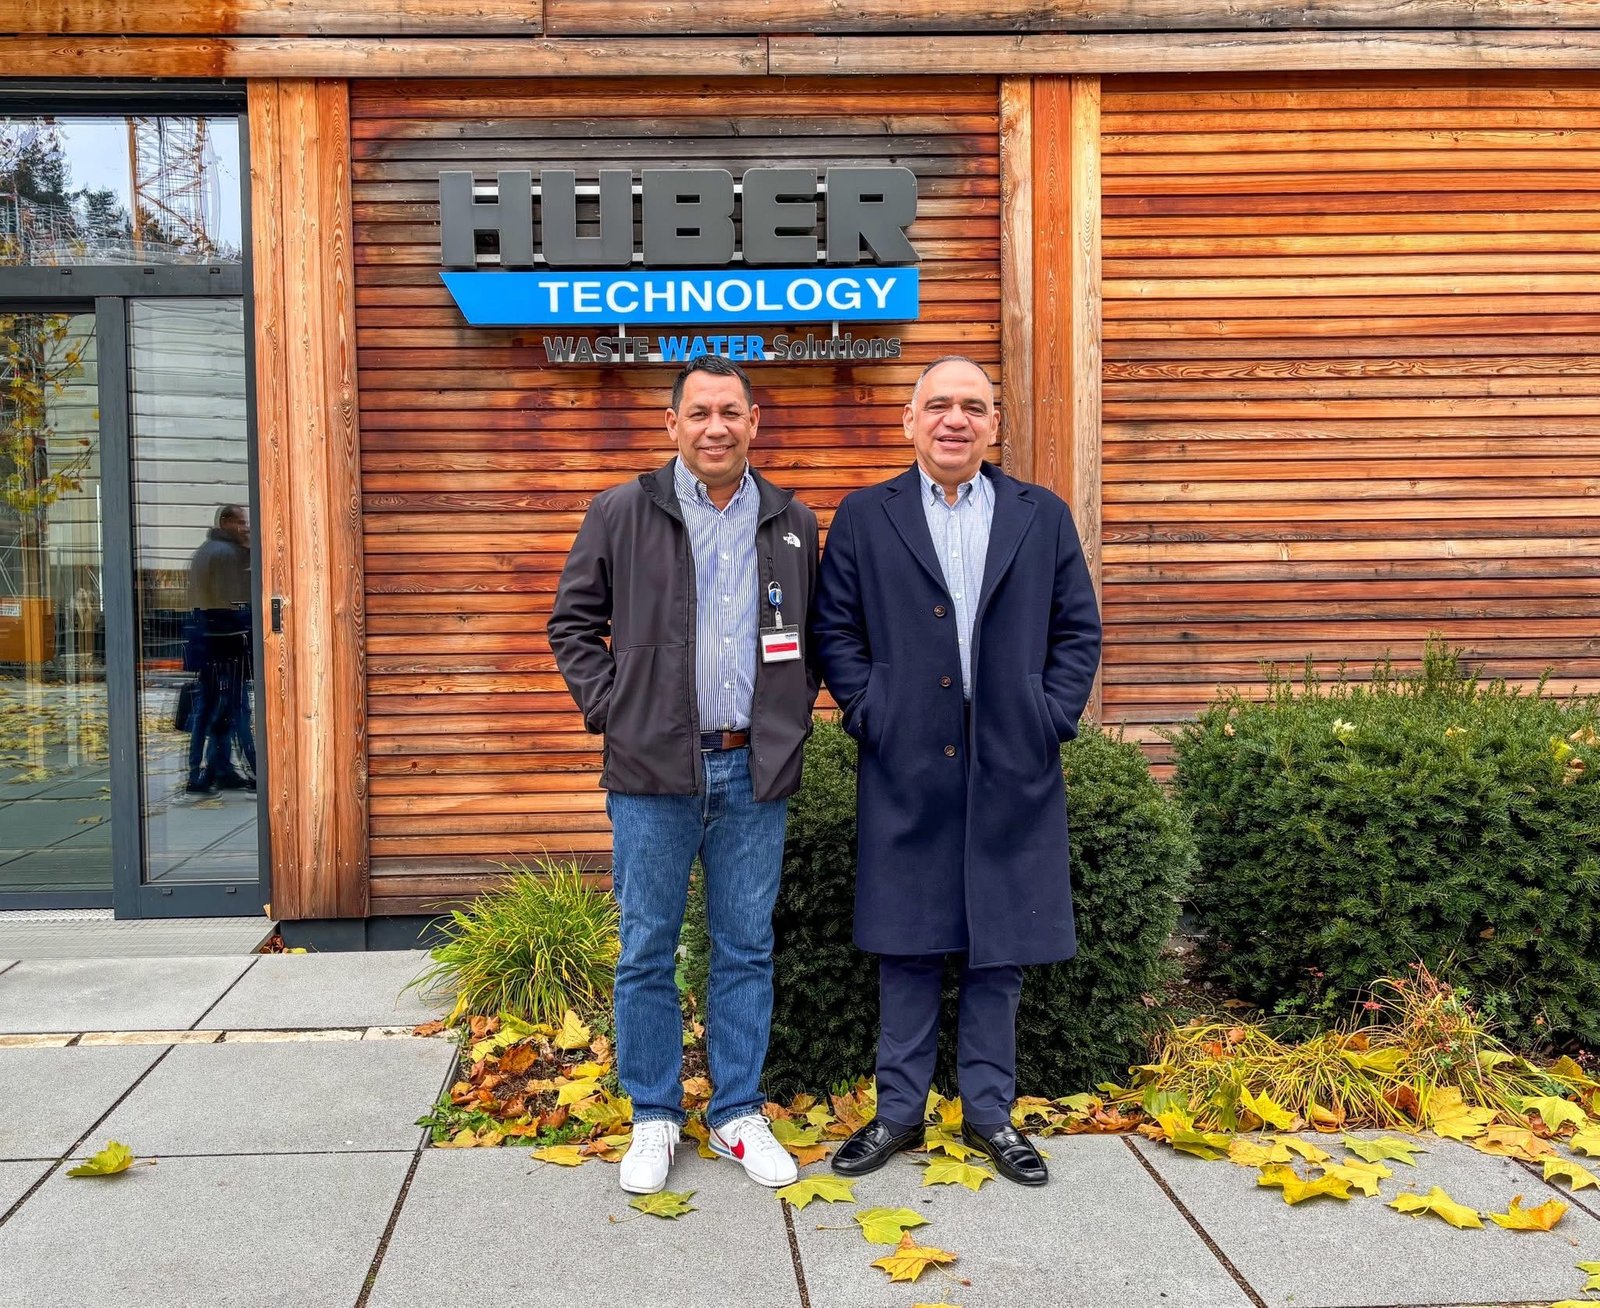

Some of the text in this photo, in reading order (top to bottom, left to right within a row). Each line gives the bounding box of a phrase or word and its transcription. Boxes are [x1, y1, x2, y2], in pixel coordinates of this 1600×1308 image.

[439, 167, 921, 268] HUBER
[538, 278, 897, 314] TECHNOLOGY
[543, 333, 901, 362] WASTE WATER Solutions
